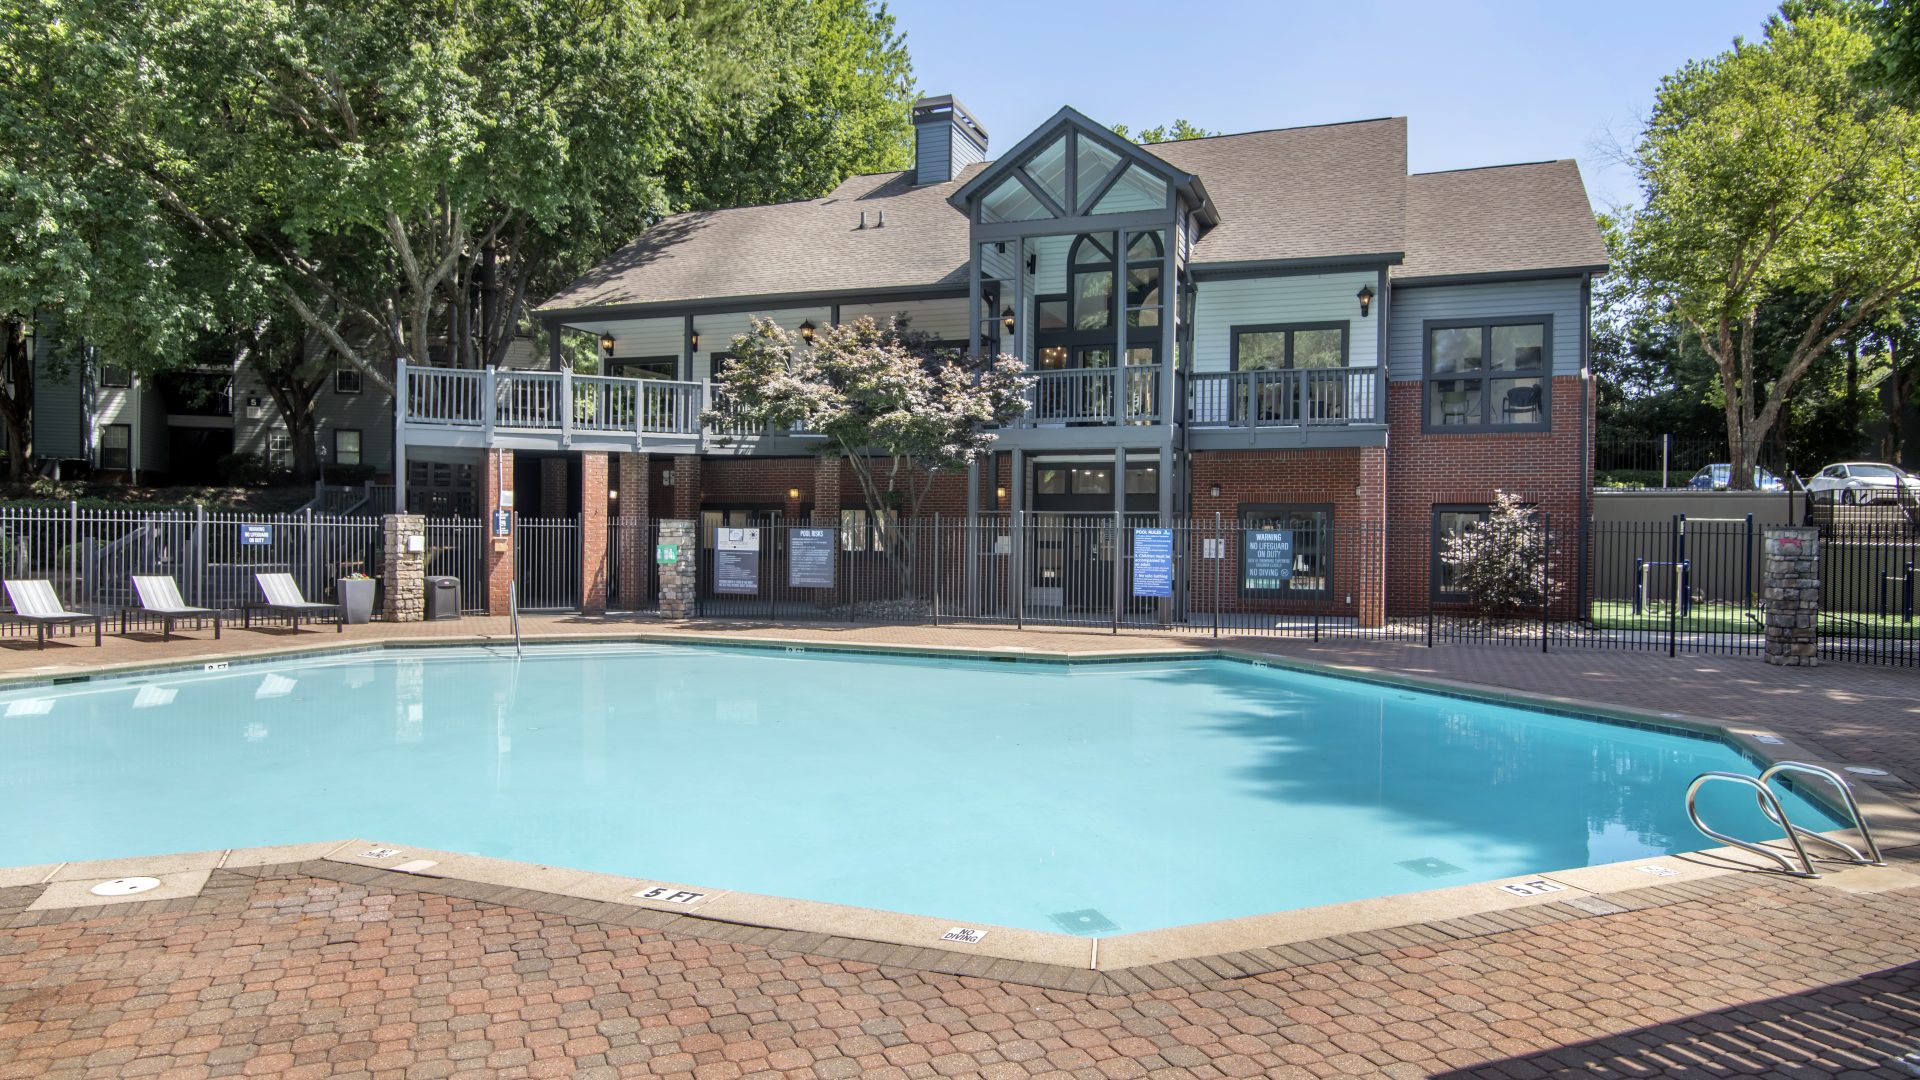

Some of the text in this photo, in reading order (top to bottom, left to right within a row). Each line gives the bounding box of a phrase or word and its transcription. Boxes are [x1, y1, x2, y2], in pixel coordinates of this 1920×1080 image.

[1256, 533, 1282, 541] WARNING
[1504, 880, 1561, 895] 5 FT
[643, 887, 705, 903] 5 FT
[944, 932, 978, 943] DIVING
